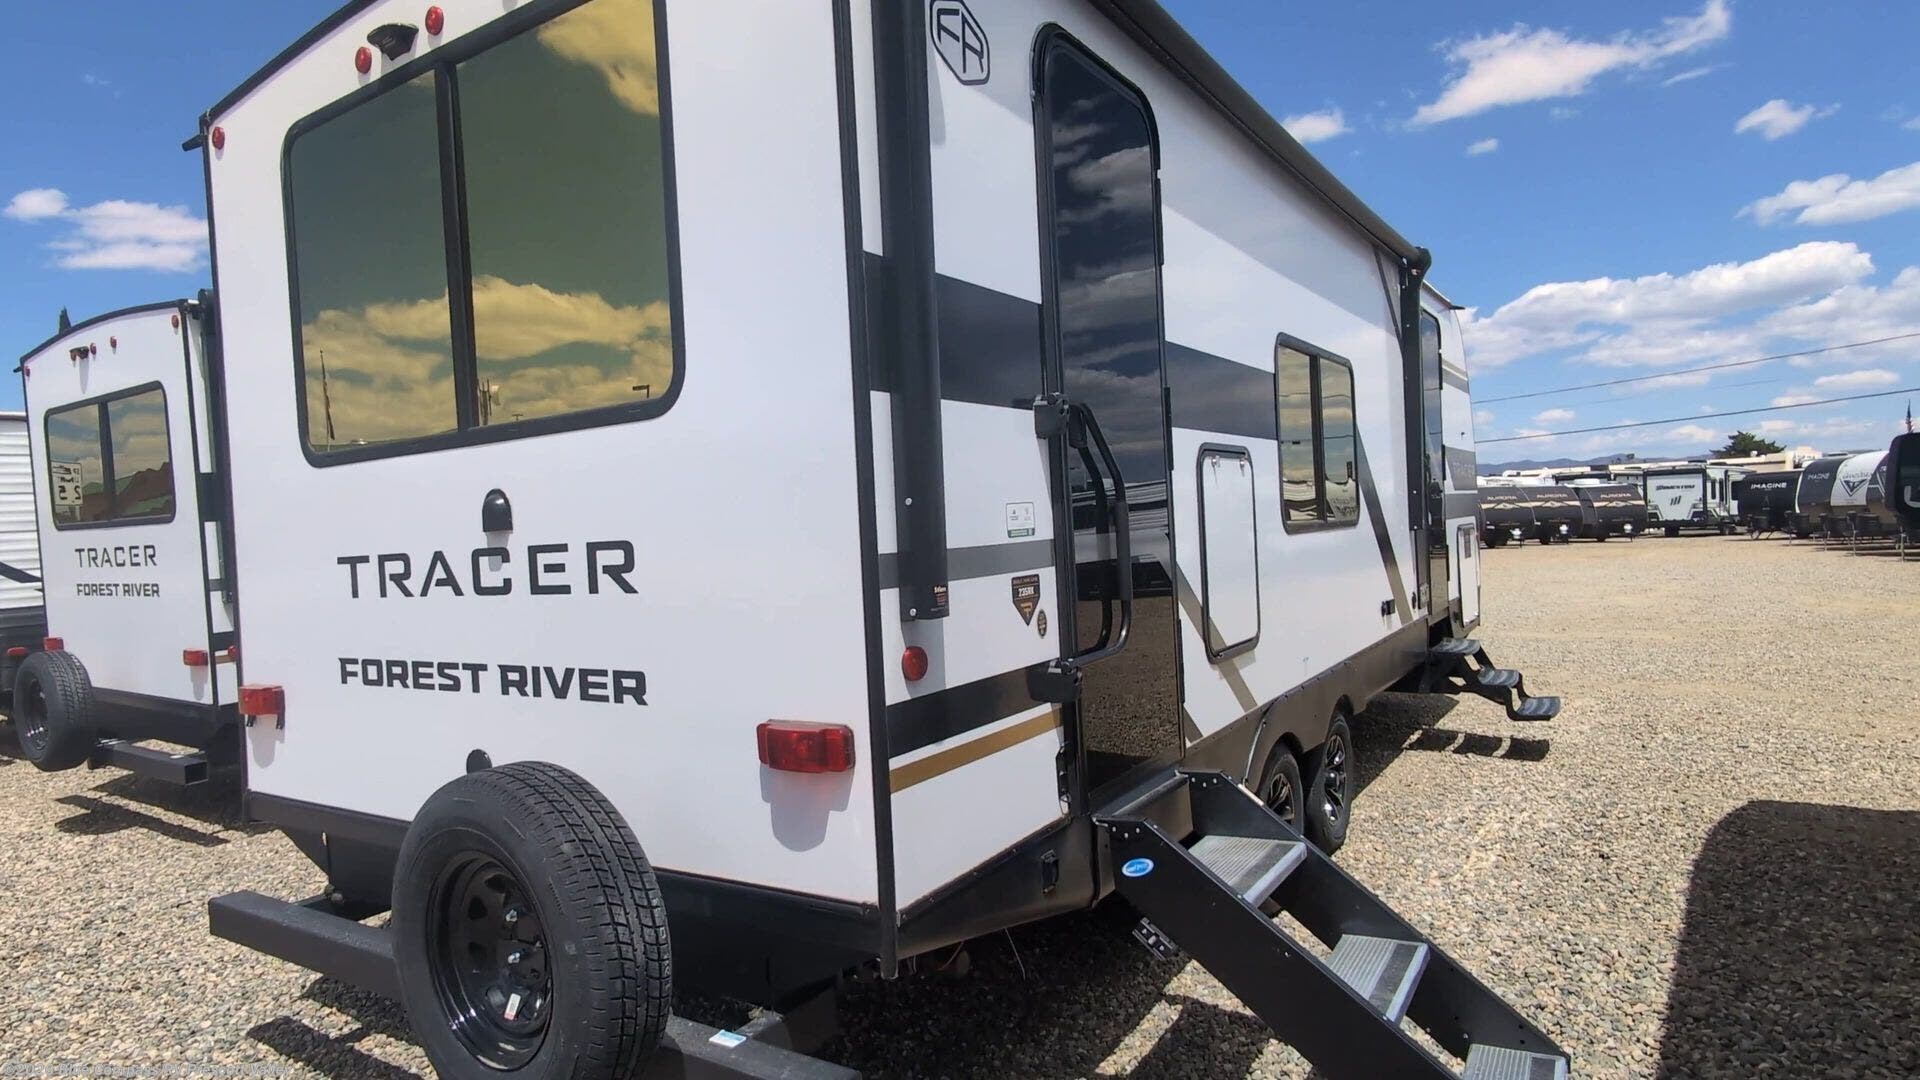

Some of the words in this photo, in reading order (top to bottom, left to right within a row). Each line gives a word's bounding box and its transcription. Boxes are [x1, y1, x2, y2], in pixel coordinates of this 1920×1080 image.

[1750, 482, 1787, 490] IMAGINE
[75, 545, 157, 568] TRACER
[337, 540, 639, 599] TRACER
[76, 583, 119, 597] FOREST
[122, 583, 160, 598] RIVER
[337, 658, 488, 694] FOREST
[498, 664, 649, 706] RIVER
